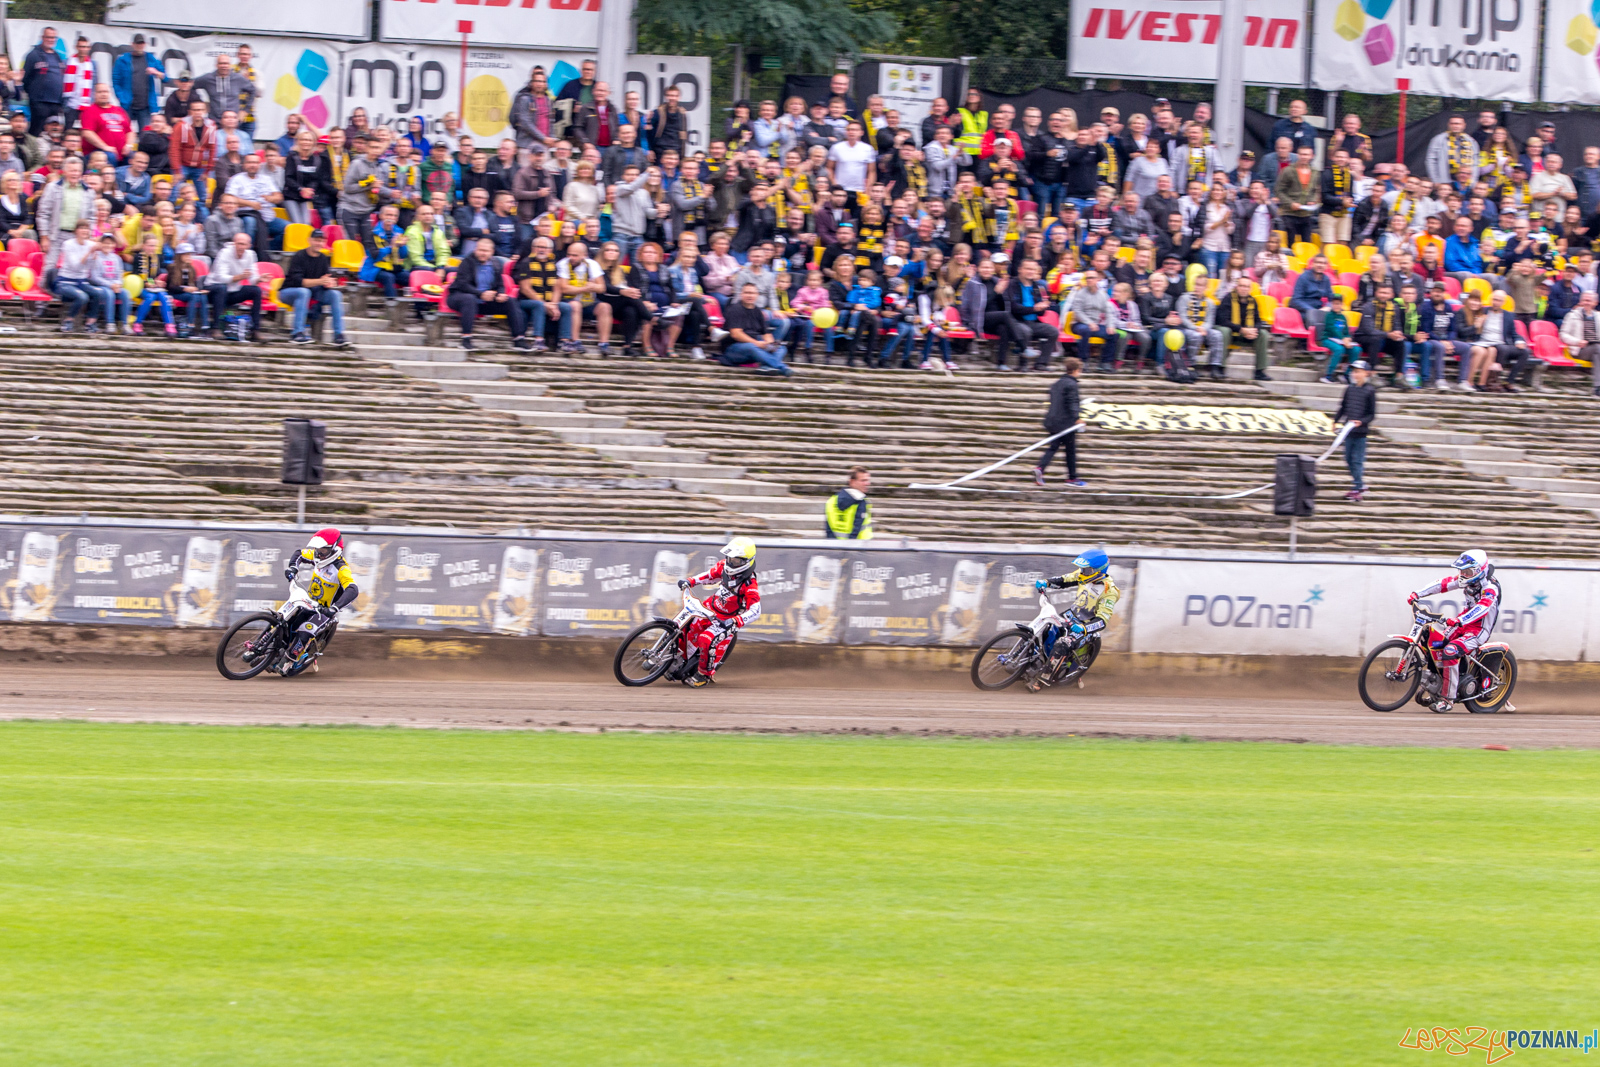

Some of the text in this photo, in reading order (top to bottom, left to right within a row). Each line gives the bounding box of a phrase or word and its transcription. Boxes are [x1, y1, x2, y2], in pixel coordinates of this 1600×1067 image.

[1406, 43, 1520, 73] drukarnia
[347, 50, 447, 113] mjp
[1182, 594, 1313, 630] POZnan
